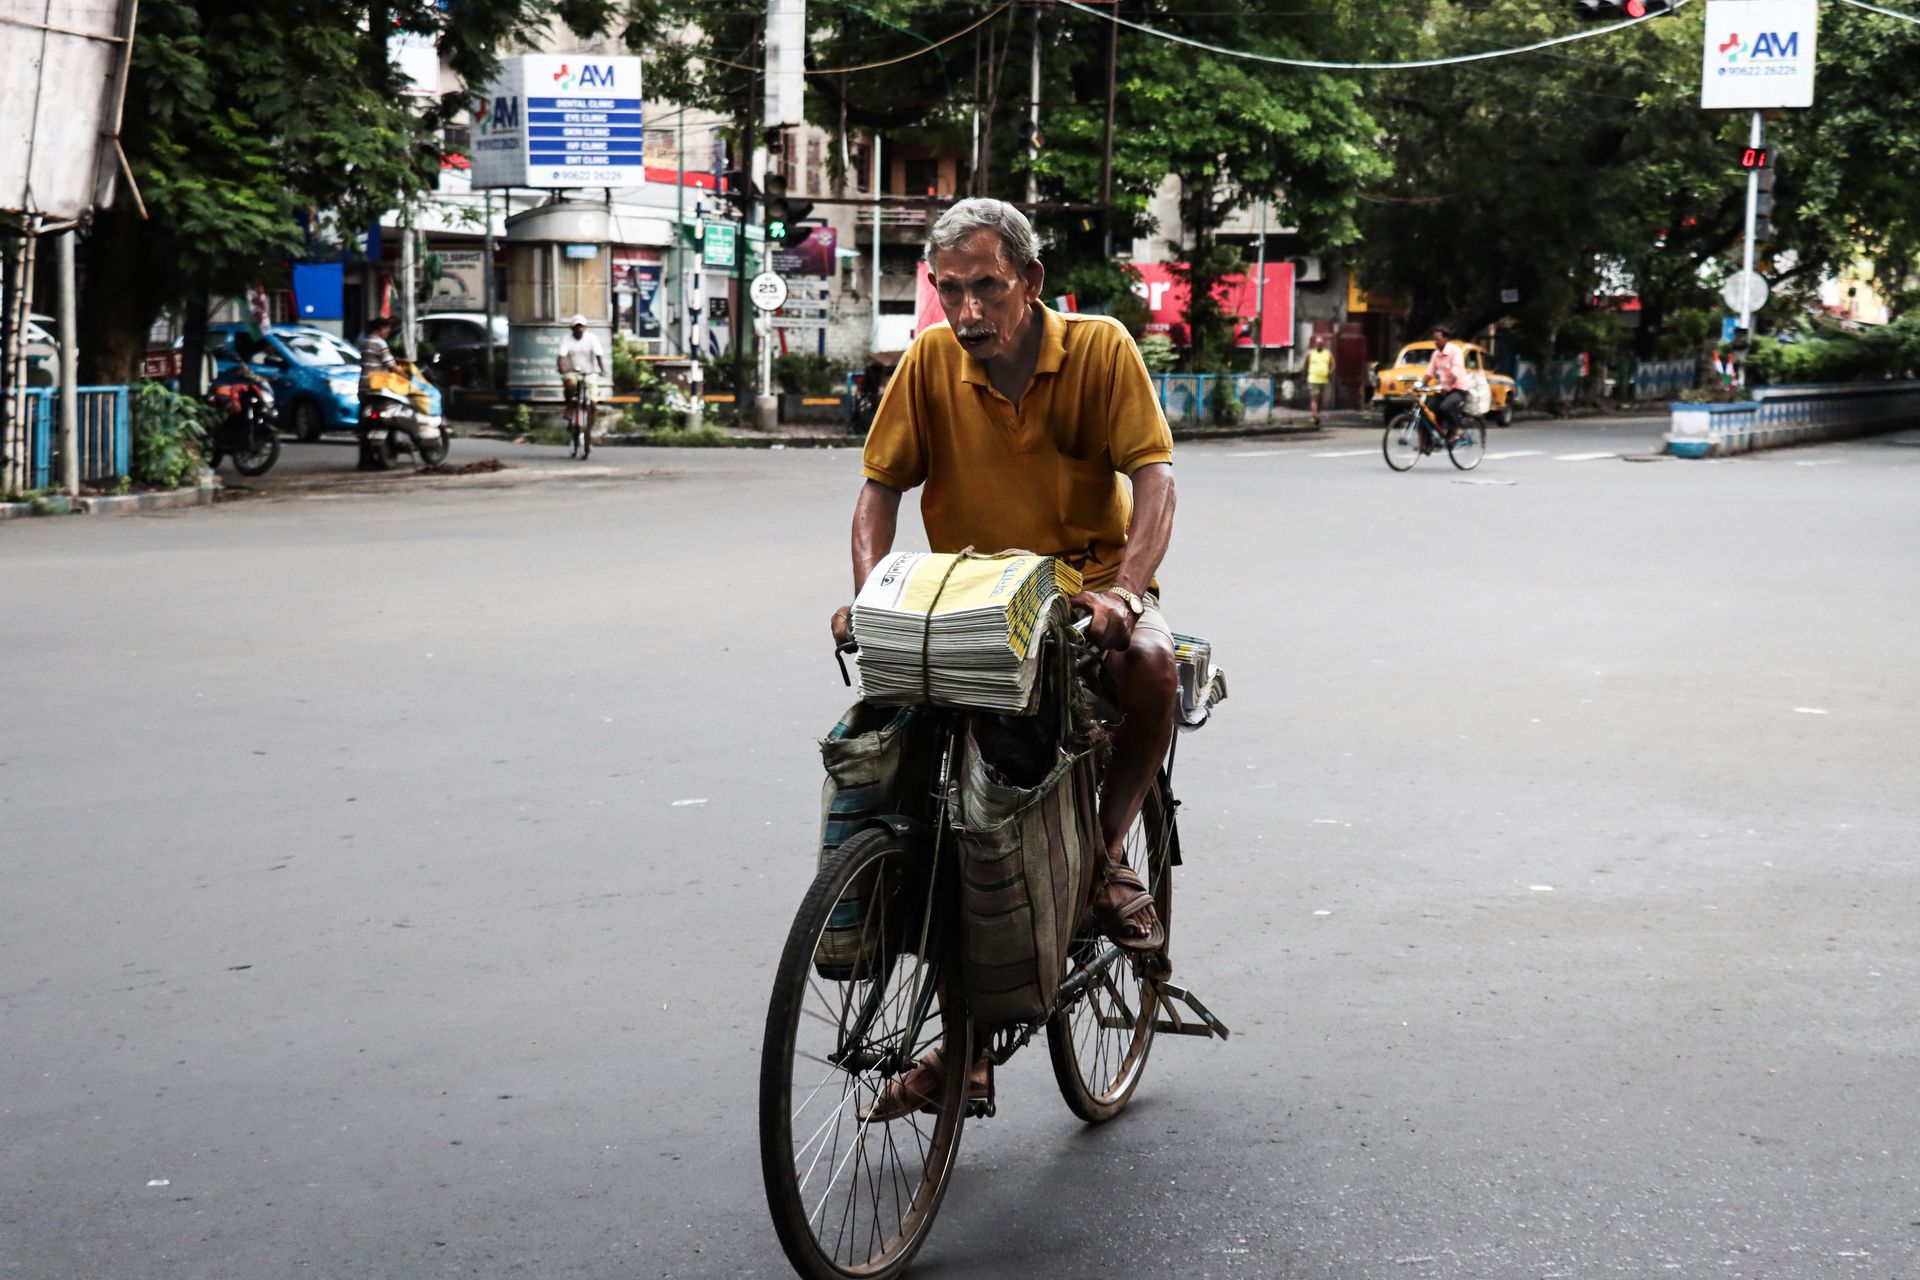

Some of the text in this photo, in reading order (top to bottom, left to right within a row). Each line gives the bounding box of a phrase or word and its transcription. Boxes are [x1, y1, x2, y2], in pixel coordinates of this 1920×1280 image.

[1750, 31, 1798, 58] AM
[579, 64, 614, 87] AM
[555, 99, 616, 109] DENTAL CLINIC
[492, 96, 519, 129] AM
[564, 113, 608, 123] EYE CLINIC
[583, 127, 610, 137] CLINIC
[581, 141, 608, 151] CLINIC
[582, 155, 610, 165] CLINIC
[1742, 149, 1766, 167] 01
[758, 283, 778, 294] 25
